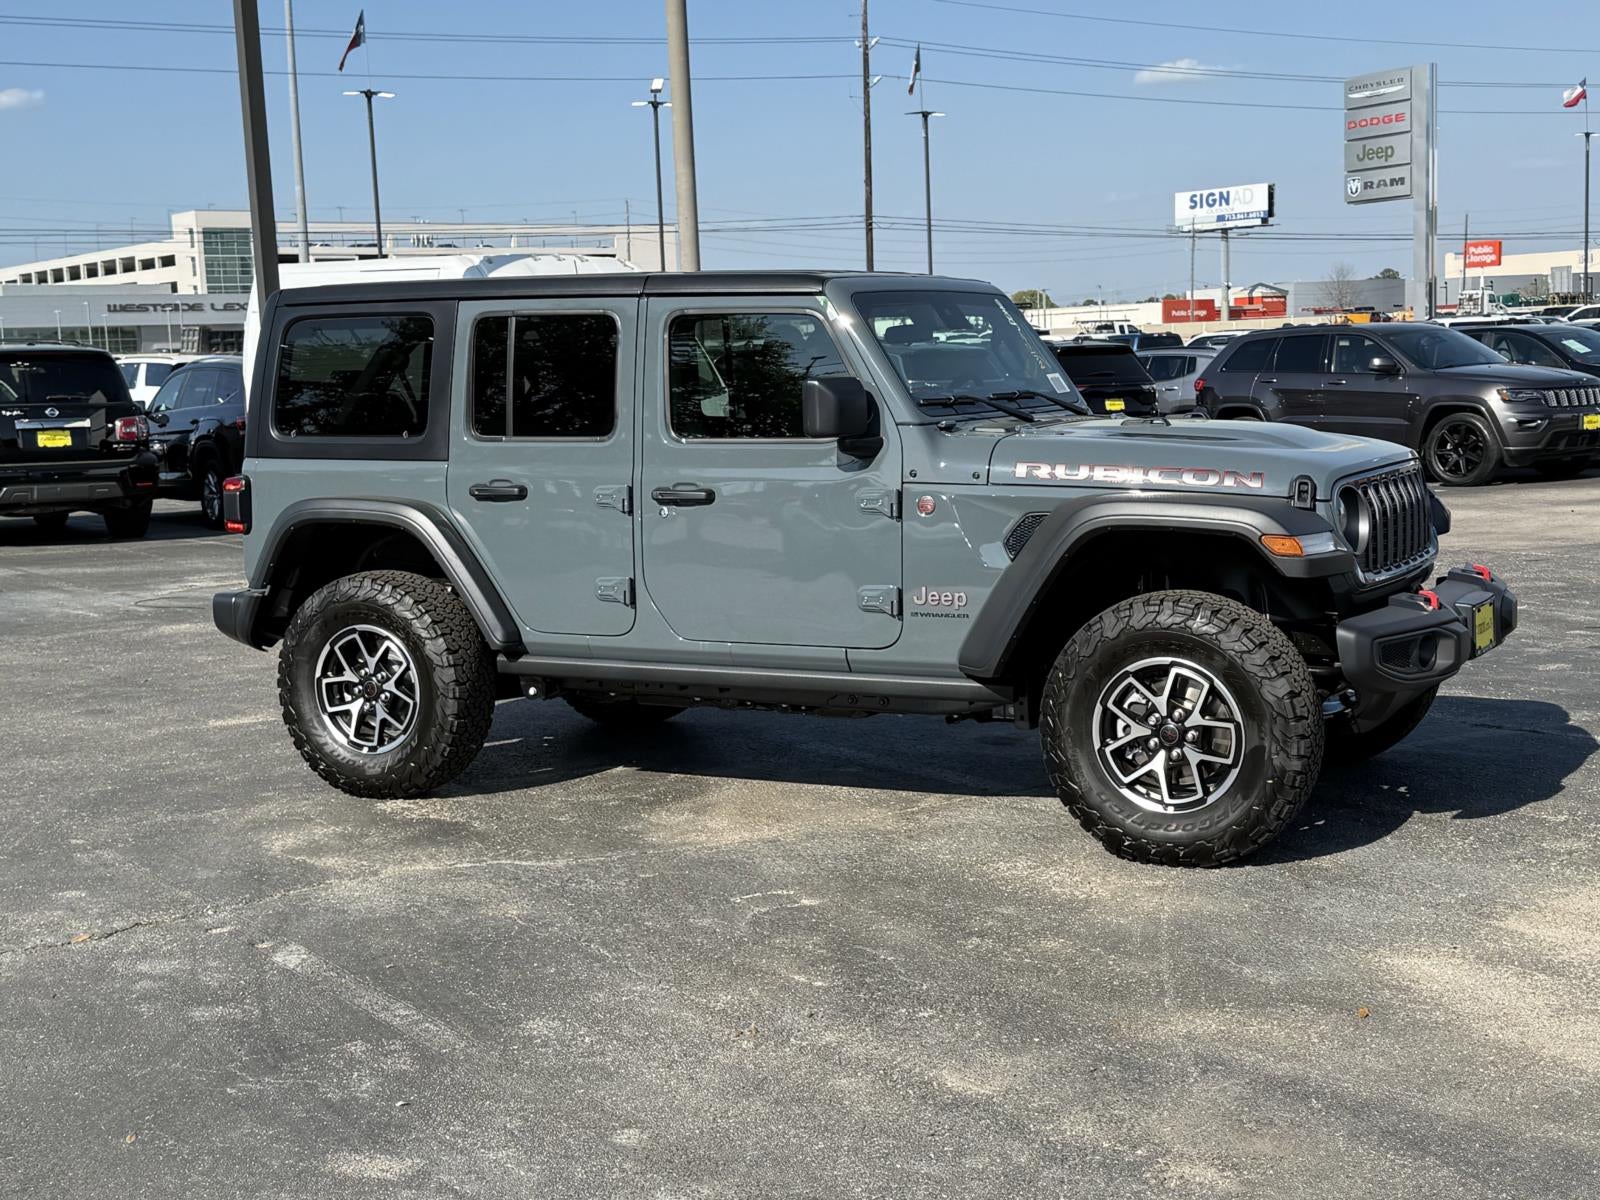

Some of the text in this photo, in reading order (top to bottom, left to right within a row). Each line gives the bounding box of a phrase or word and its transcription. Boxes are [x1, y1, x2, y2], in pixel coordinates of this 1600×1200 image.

[1348, 77, 1405, 92] CHRYSLER
[1347, 112, 1406, 130] DODGE
[1356, 144, 1395, 162] Jeep
[1363, 177, 1405, 190] RAM
[1468, 245, 1494, 255] Public
[107, 302, 205, 313] WESTSIDE
[1187, 309, 1208, 317] Sorage
[1014, 462, 1265, 489] RUBICON
[913, 586, 967, 610] Jeep
[919, 611, 970, 619] WRANGLER
